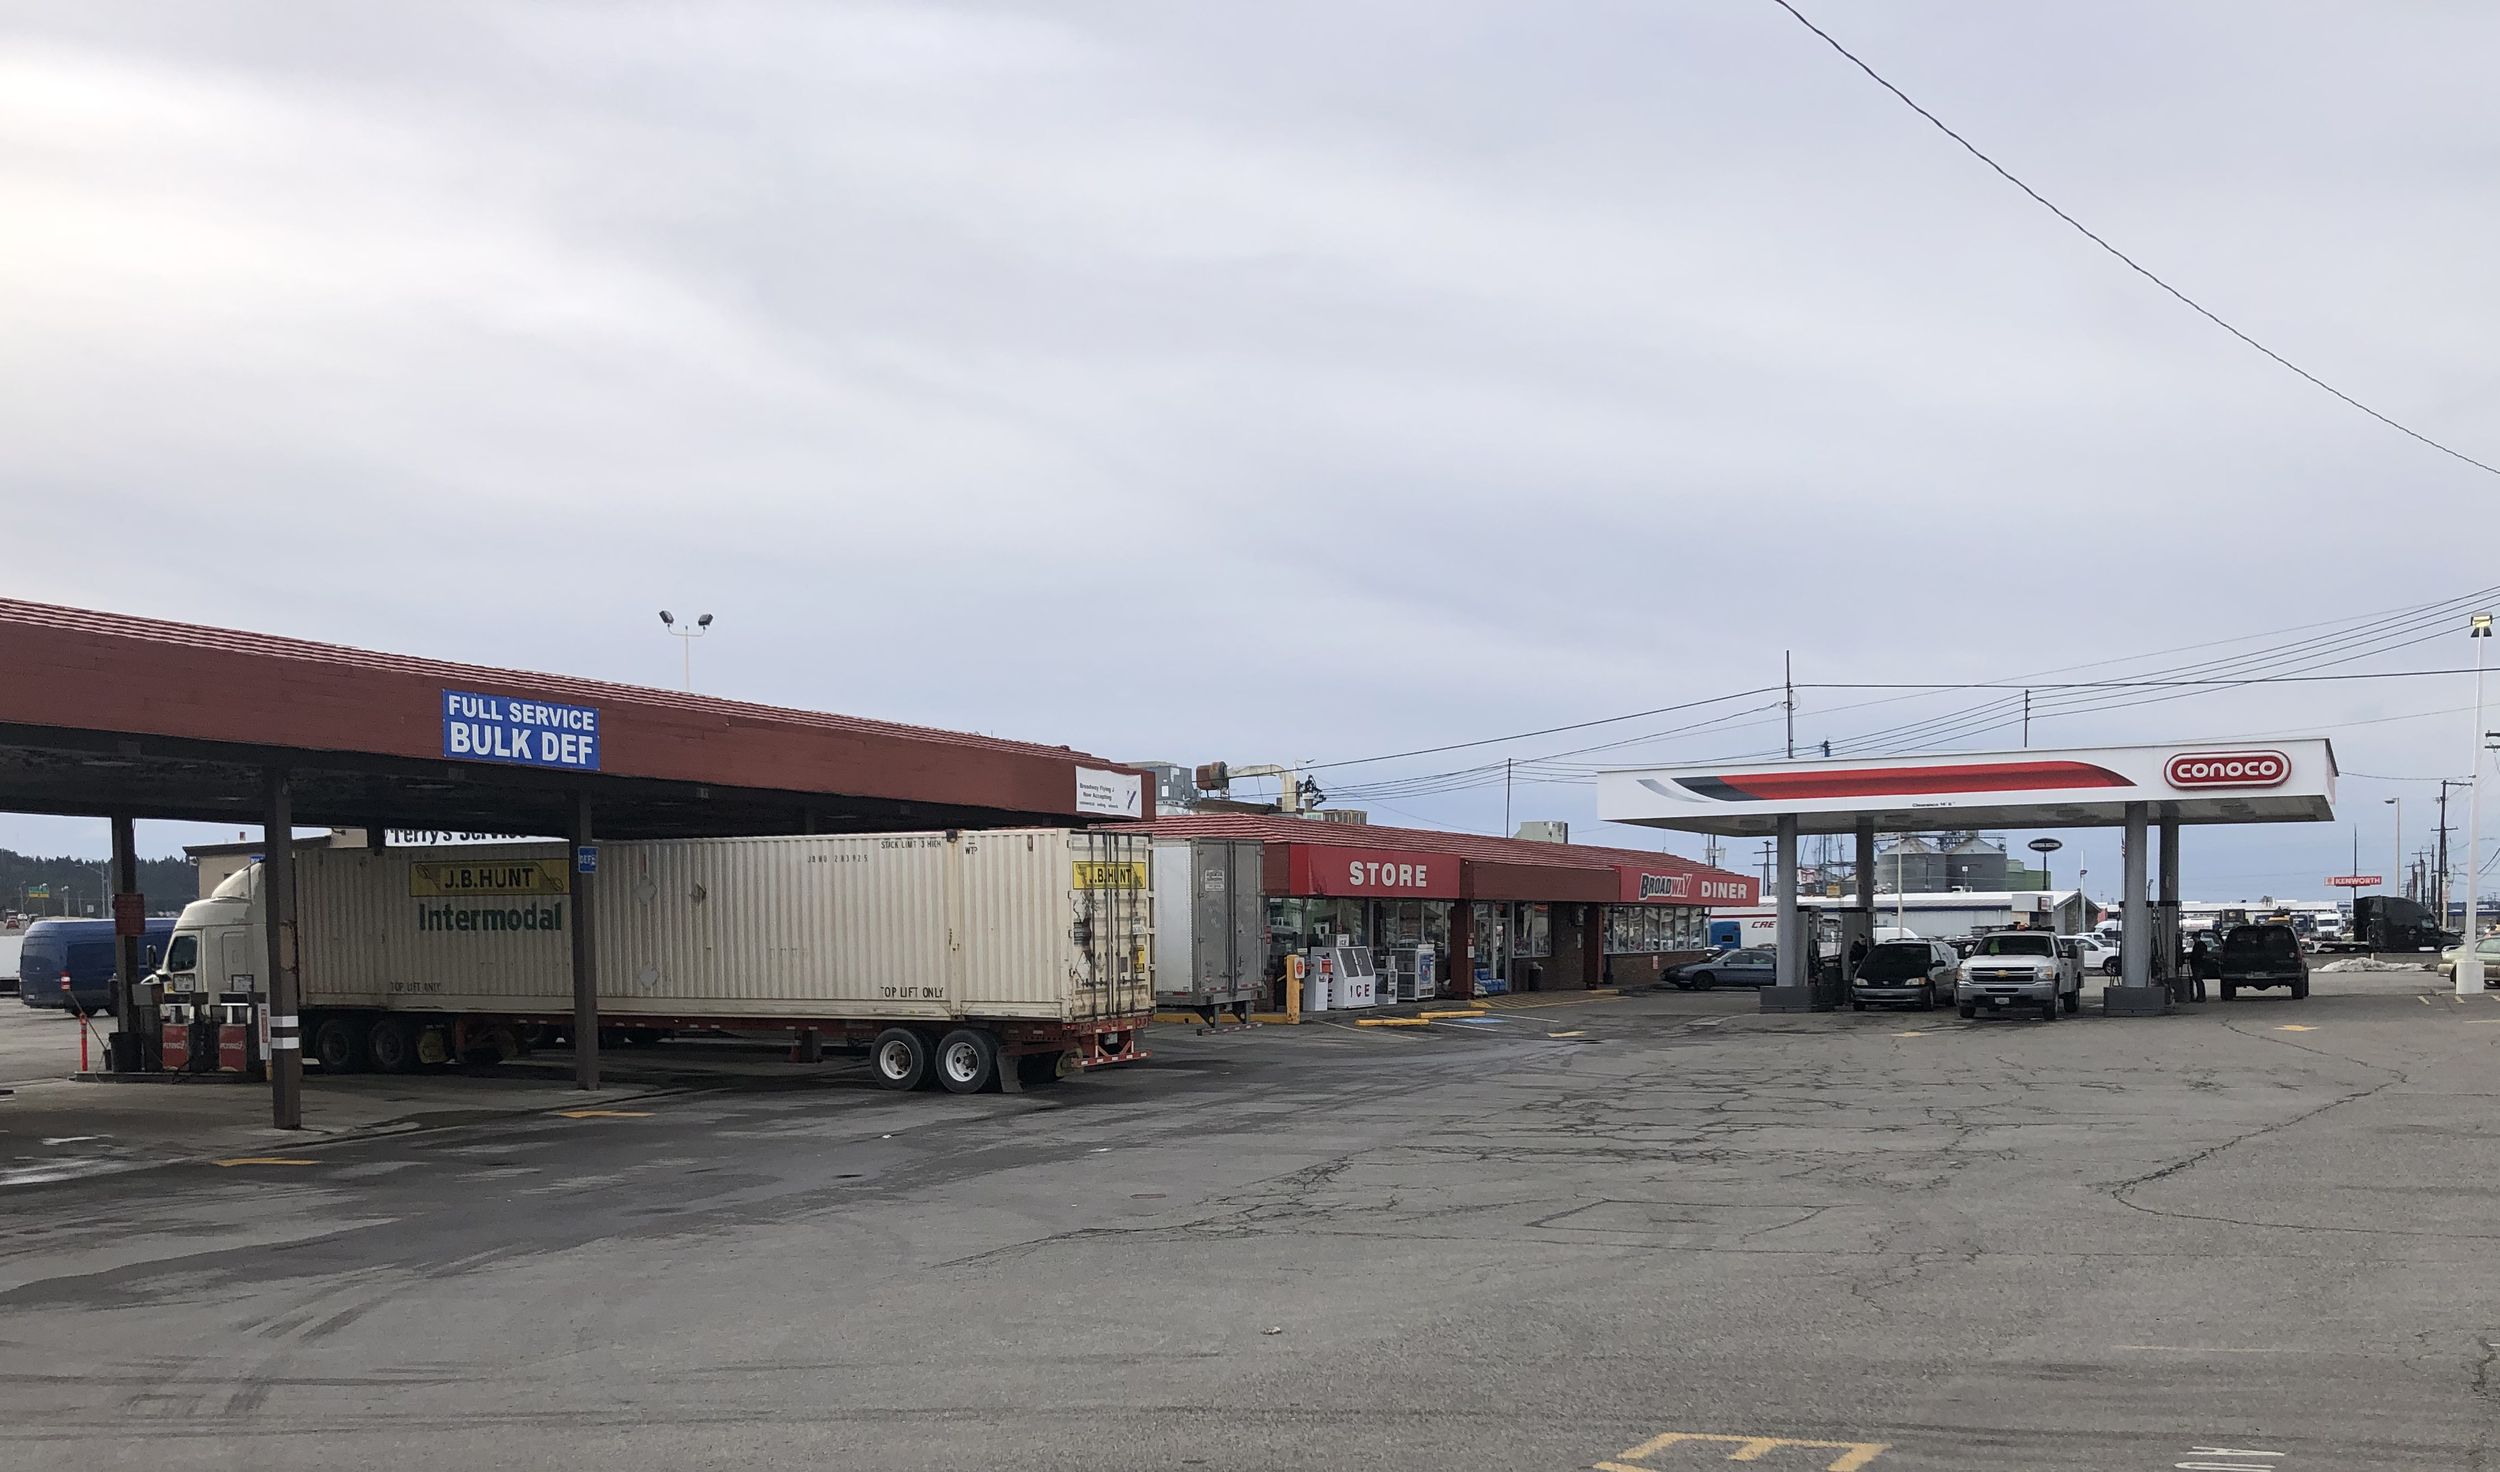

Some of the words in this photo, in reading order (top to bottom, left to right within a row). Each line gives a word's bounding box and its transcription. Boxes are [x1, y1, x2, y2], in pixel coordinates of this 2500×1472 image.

[449, 695, 503, 721] FULL
[509, 702, 595, 731] SERVICE
[450, 722, 532, 760] BULK
[541, 731, 593, 765] DEF
[444, 868, 534, 889] J.B.HUNT
[1350, 861, 1427, 887] STORE
[2335, 877, 2380, 885] KENWORTH
[1702, 881, 1747, 899] DINER
[419, 902, 562, 931] Intermodal
[900, 987, 918, 998] LIFT
[923, 987, 944, 998] ONLY
[1350, 984, 1370, 998] ICE
